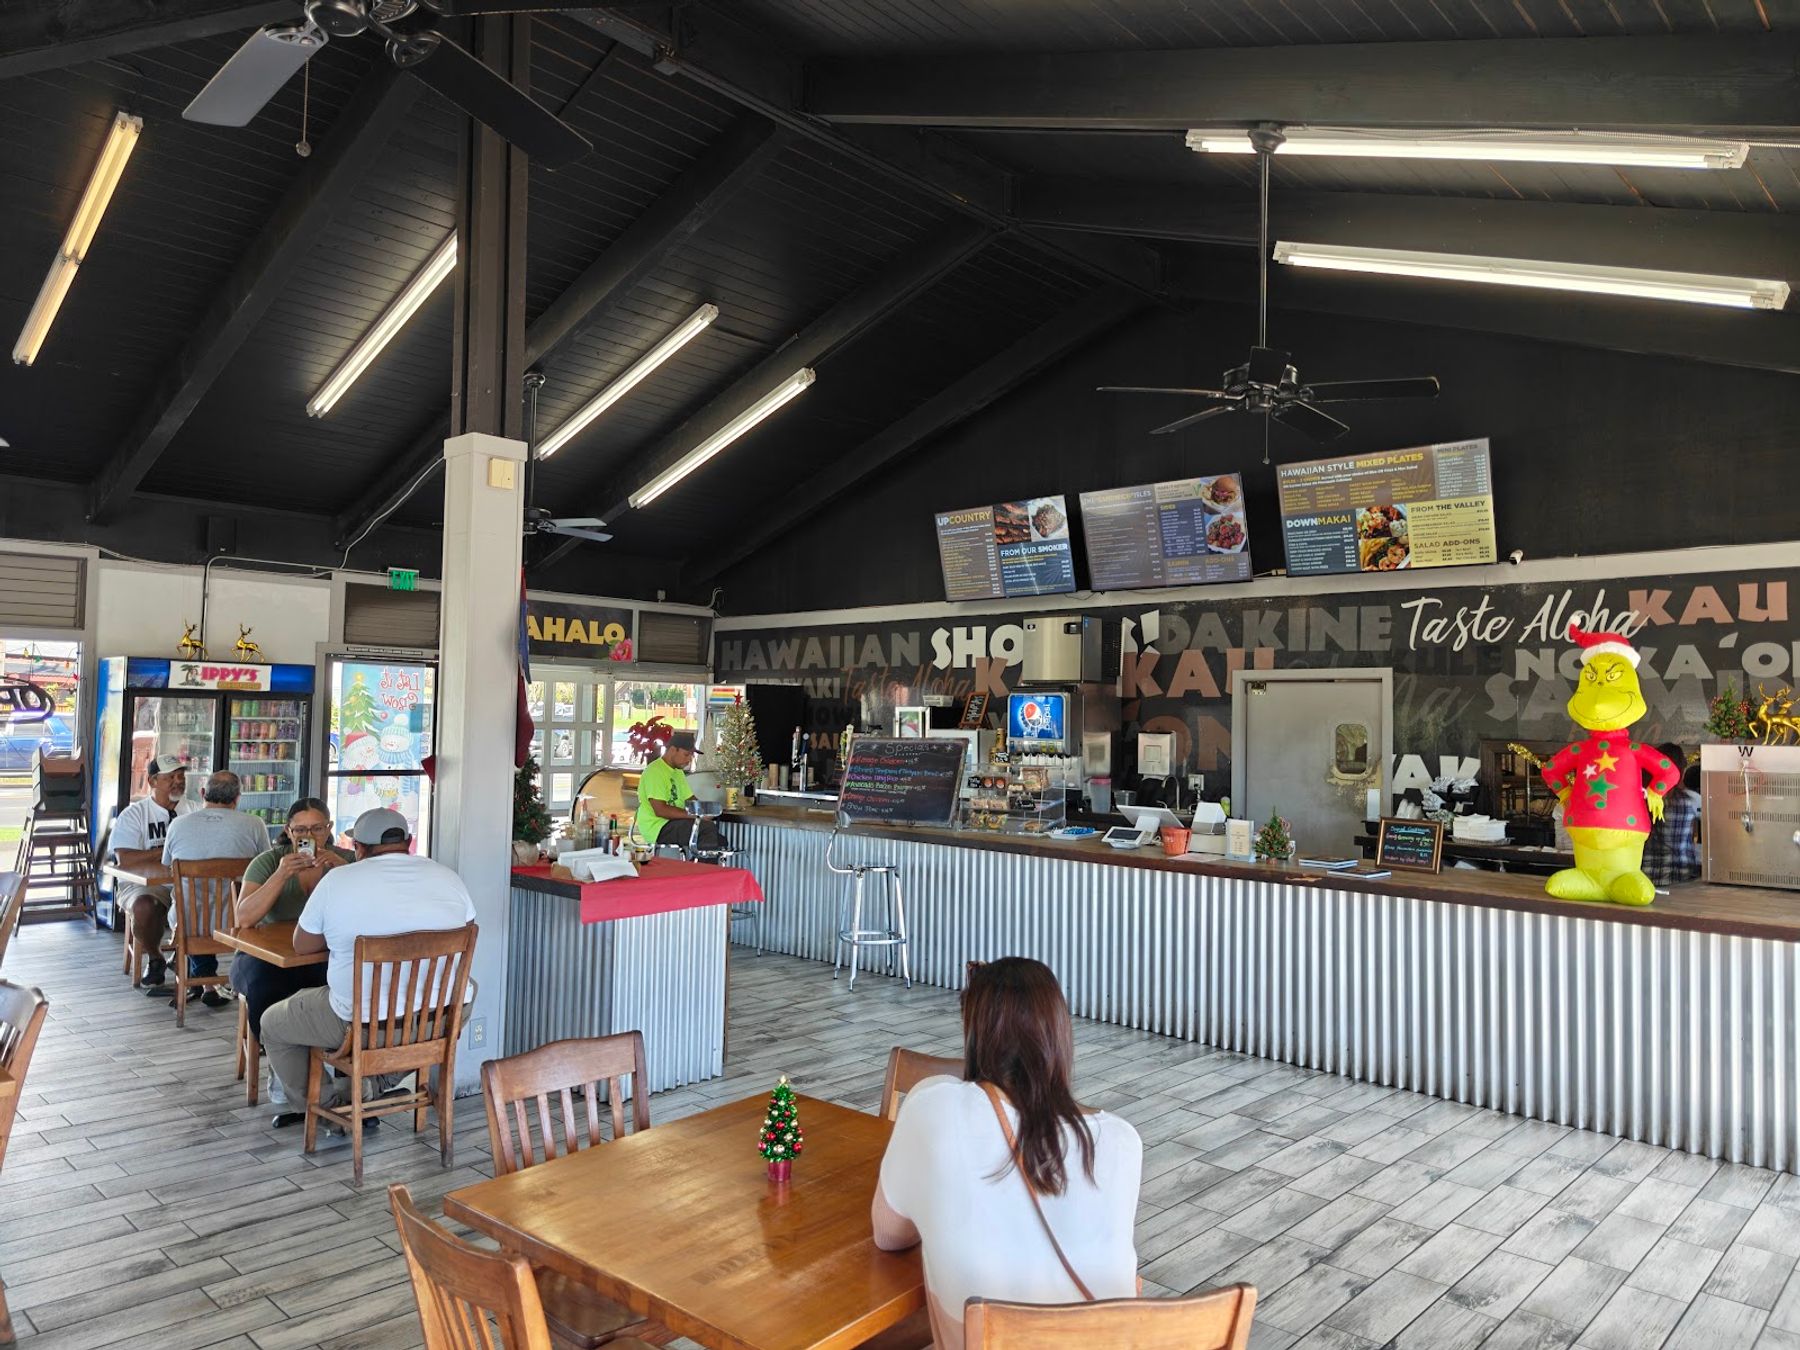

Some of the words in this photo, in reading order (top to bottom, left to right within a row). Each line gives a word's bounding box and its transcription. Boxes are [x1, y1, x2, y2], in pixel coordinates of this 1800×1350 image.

[1281, 465, 1325, 477] HAWAIIAN
[1327, 461, 1355, 472] STYLE
[1356, 457, 1385, 468] MIXED
[1387, 453, 1424, 464] PLATES
[1411, 505, 1434, 513] FROM
[1454, 500, 1486, 509] VALLEY
[937, 510, 992, 526] UPCOUNTRY
[1286, 515, 1351, 529] DOWNMAKAI
[1001, 547, 1020, 557] FROM
[1021, 545, 1037, 555] OUR
[1038, 543, 1068, 554] SMOKER
[1414, 540, 1441, 549] SALAD
[1443, 538, 1480, 548] ADD-ONS
[391, 570, 417, 591] EXIT
[1628, 581, 1788, 628] KAU
[1400, 595, 1515, 652] Taste
[1518, 588, 1652, 646] Aloha
[527, 615, 626, 645] AHALO
[720, 631, 921, 671] HAWAIIAN
[1042, 703, 1052, 734] pepsi
[884, 742, 930, 756] Specials
[1738, 745, 1754, 757] W
